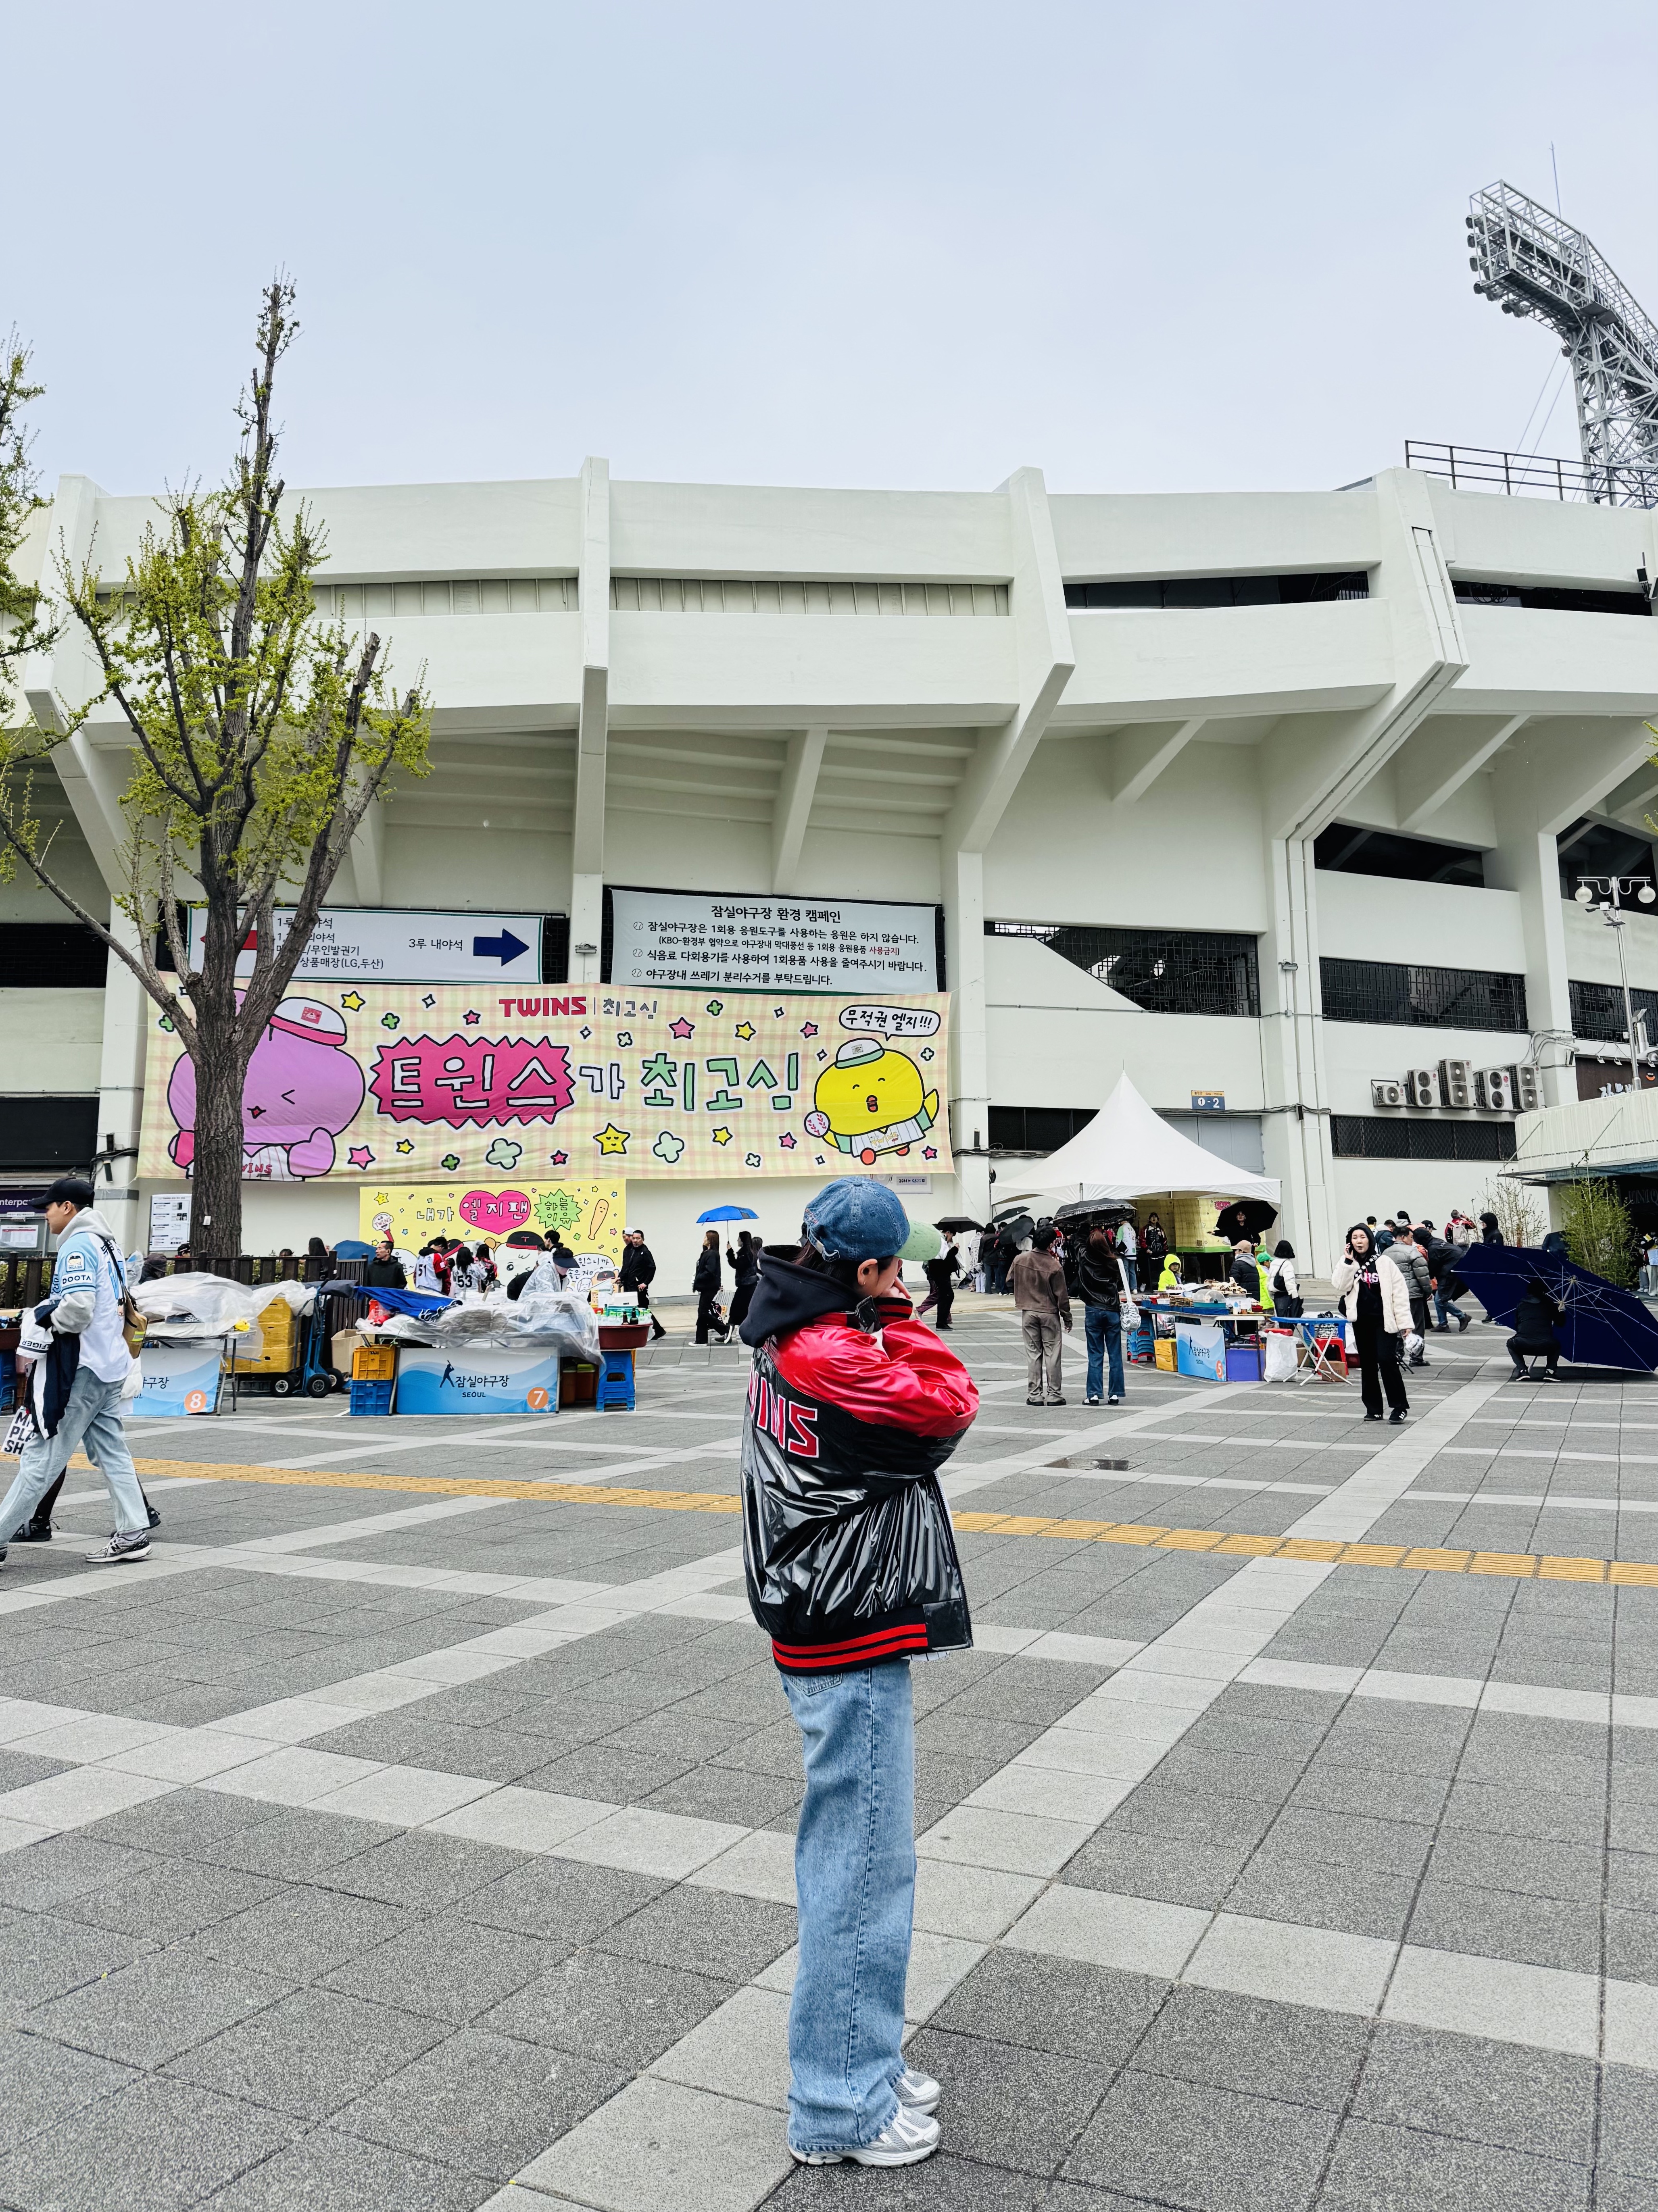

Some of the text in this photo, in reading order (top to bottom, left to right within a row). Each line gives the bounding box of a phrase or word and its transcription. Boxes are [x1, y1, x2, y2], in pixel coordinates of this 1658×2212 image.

[711, 906, 840, 923] 잠실야구장 환경 캠페인
[648, 921, 919, 944] 잠실야구장은 1회용 응원도구를 사용하는 응원은 하지 않습니다.
[409, 939, 463, 951] 3루 내야석
[659, 936, 899, 956] (KBO-환경부 협약으로 야구장내 막대풍선 등 1회용 응원용품 사용금지)
[647, 950, 927, 972] 식음료 다회용기를 사용하여 1회용품 사용을 줄여주시기 바랍니다.
[646, 969, 832, 985] 야구장내 쓰레기 분리수거를 부탁드립니다.
[499, 996, 586, 1017] TWINS
[603, 998, 657, 1019] 최고심
[846, 1010, 932, 1031] 무적권 엘지!!!
[641, 1052, 800, 1112] 최고심
[417, 1206, 454, 1222] 내가
[578, 1258, 609, 1266] 윈스니까
[418, 1264, 426, 1277] 51
[63, 1275, 91, 1284] DOOTA
[457, 1275, 472, 1288] 53
[1218, 1363, 1222, 1375] 5
[455, 1375, 509, 1387] 잠실야구장
[190, 1393, 202, 1409] 8
[533, 1391, 544, 1406] 7
